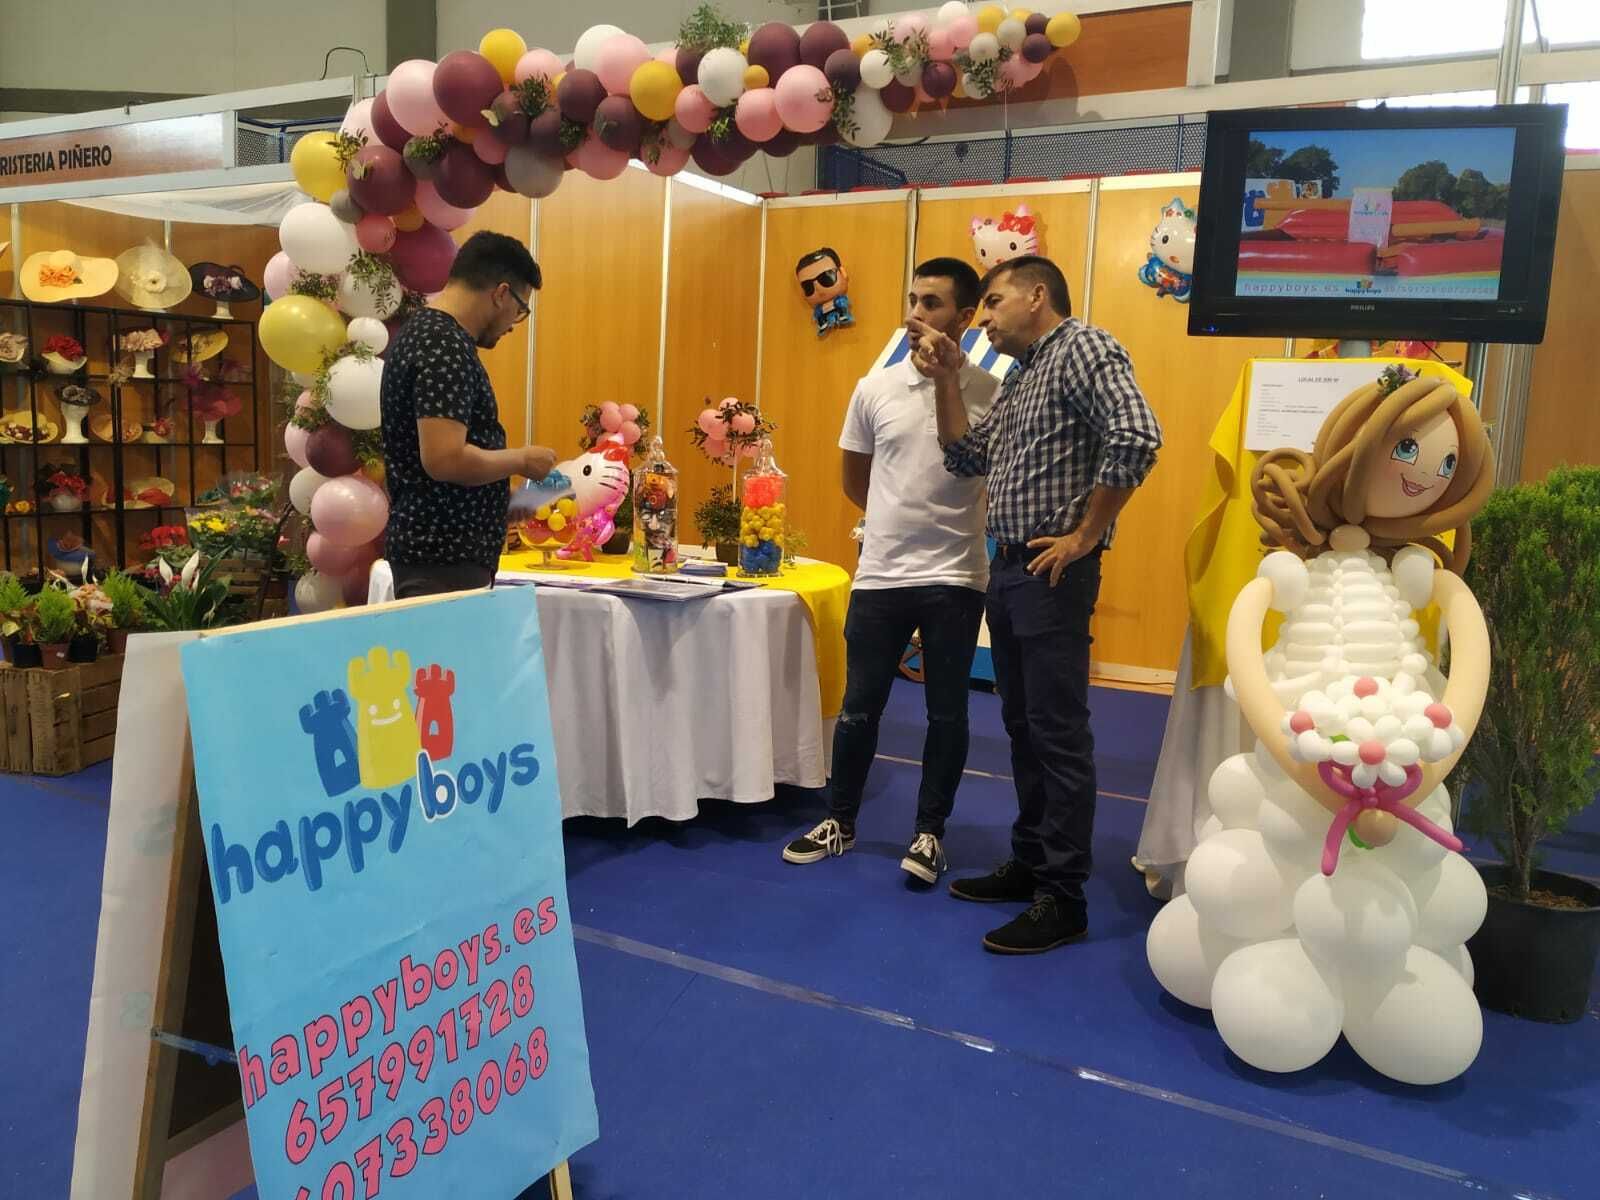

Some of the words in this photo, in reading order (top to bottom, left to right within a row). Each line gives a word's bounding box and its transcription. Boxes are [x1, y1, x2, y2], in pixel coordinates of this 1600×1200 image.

[0, 151, 55, 176] RISTERIA
[59, 144, 112, 170] PIÑERO
[239, 896, 558, 1109] happyboys.es
[285, 965, 535, 1165] 657991728
[295, 1027, 549, 1200] 07338068
